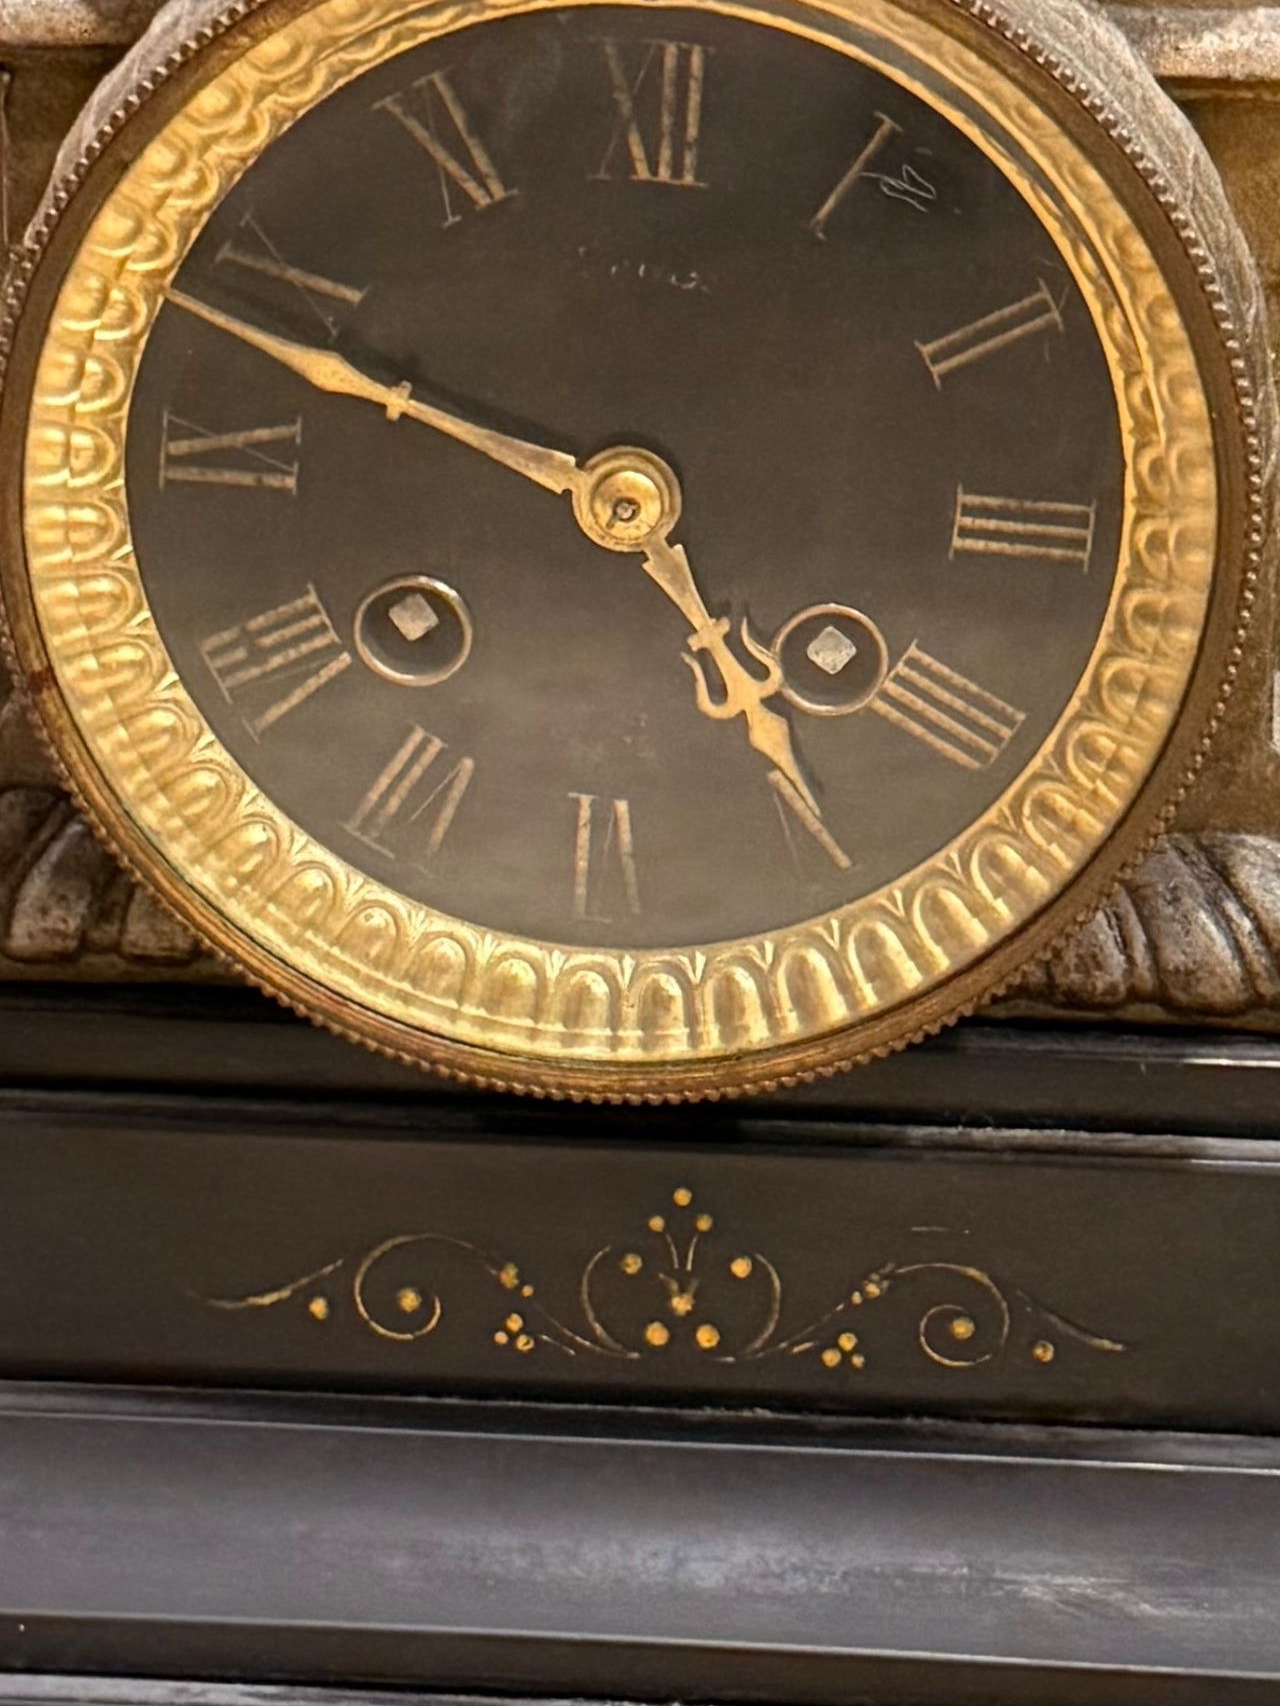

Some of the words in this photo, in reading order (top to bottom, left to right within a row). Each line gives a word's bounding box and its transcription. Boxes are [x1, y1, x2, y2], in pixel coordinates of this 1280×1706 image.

[371, 65, 520, 231] XI
[582, 39, 717, 190] XII
[214, 207, 372, 342] X
[914, 277, 1064, 392] II
[158, 406, 303, 498] IX
[948, 482, 1096, 574] III
[198, 583, 354, 745] VIII
[871, 638, 1027, 773] IIII
[340, 719, 477, 881] VII
[567, 791, 644, 925] VI
